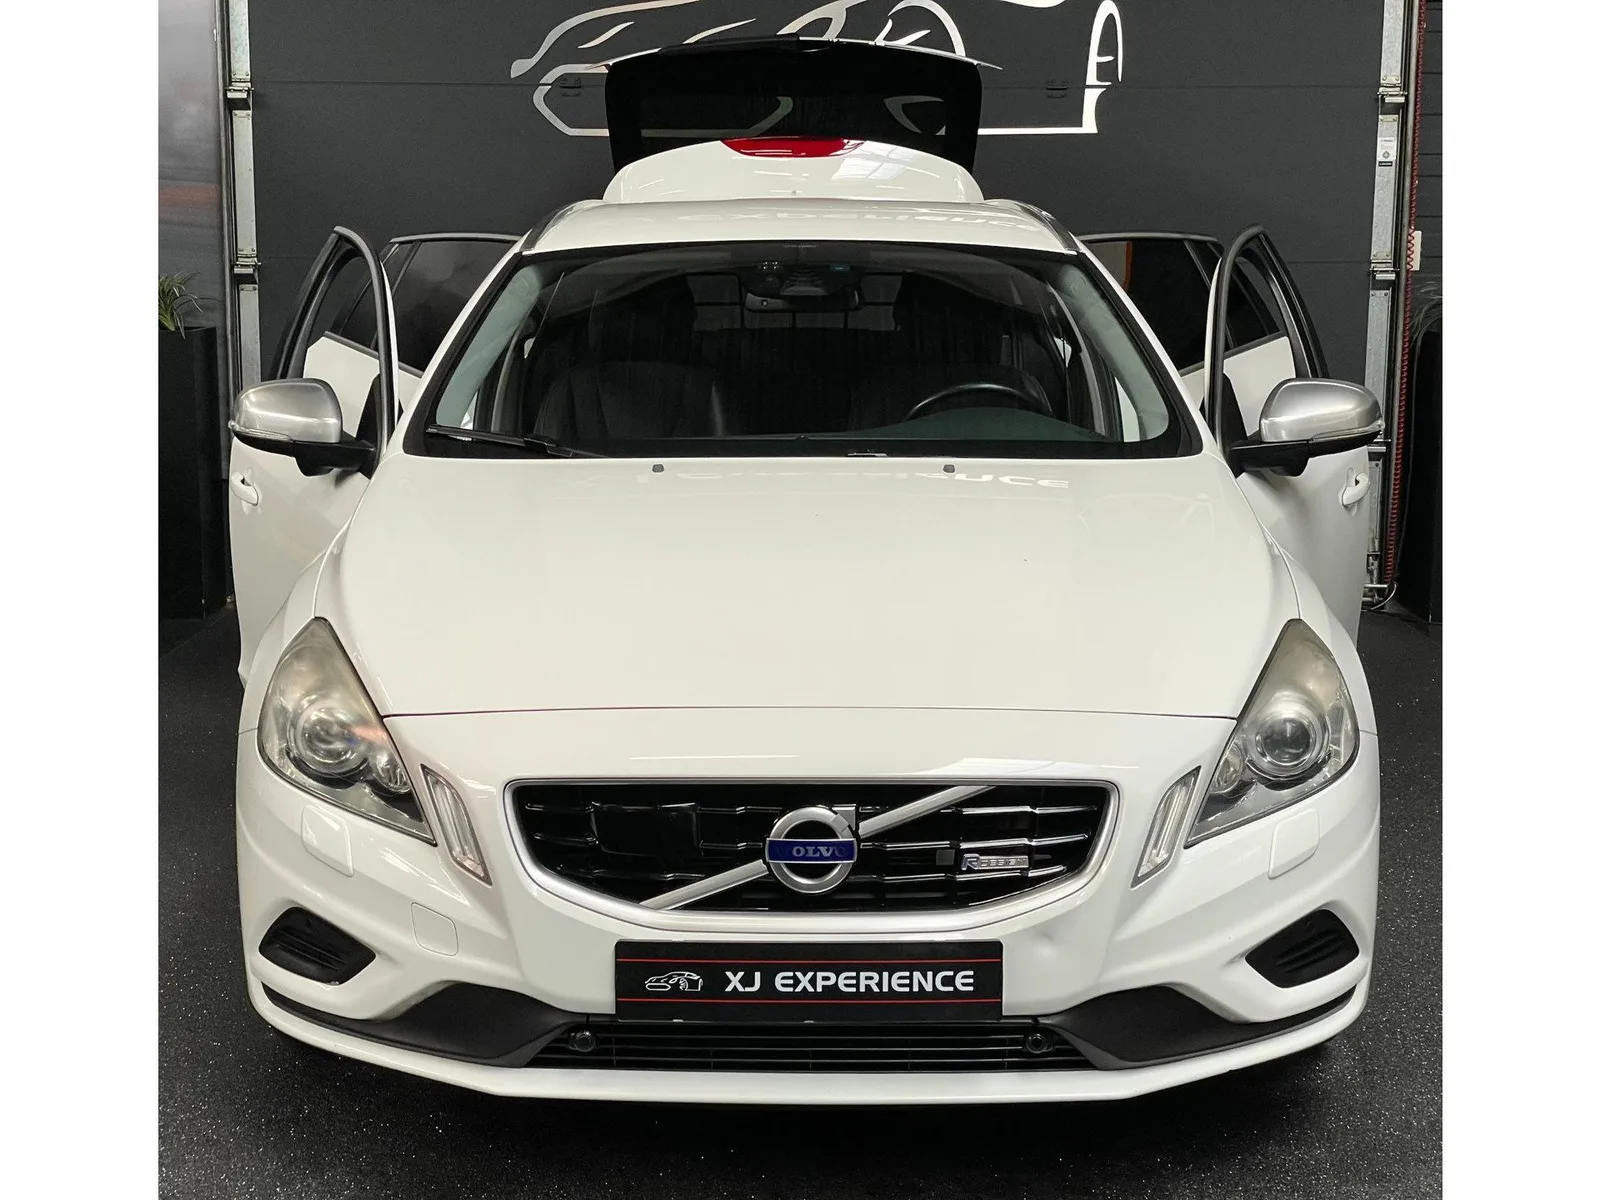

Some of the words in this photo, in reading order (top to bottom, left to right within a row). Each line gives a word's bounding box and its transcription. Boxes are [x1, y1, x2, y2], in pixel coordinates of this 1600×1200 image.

[778, 845, 847, 858] OLV
[724, 970, 762, 992] XJ
[774, 970, 975, 992] EXPERIENCE
